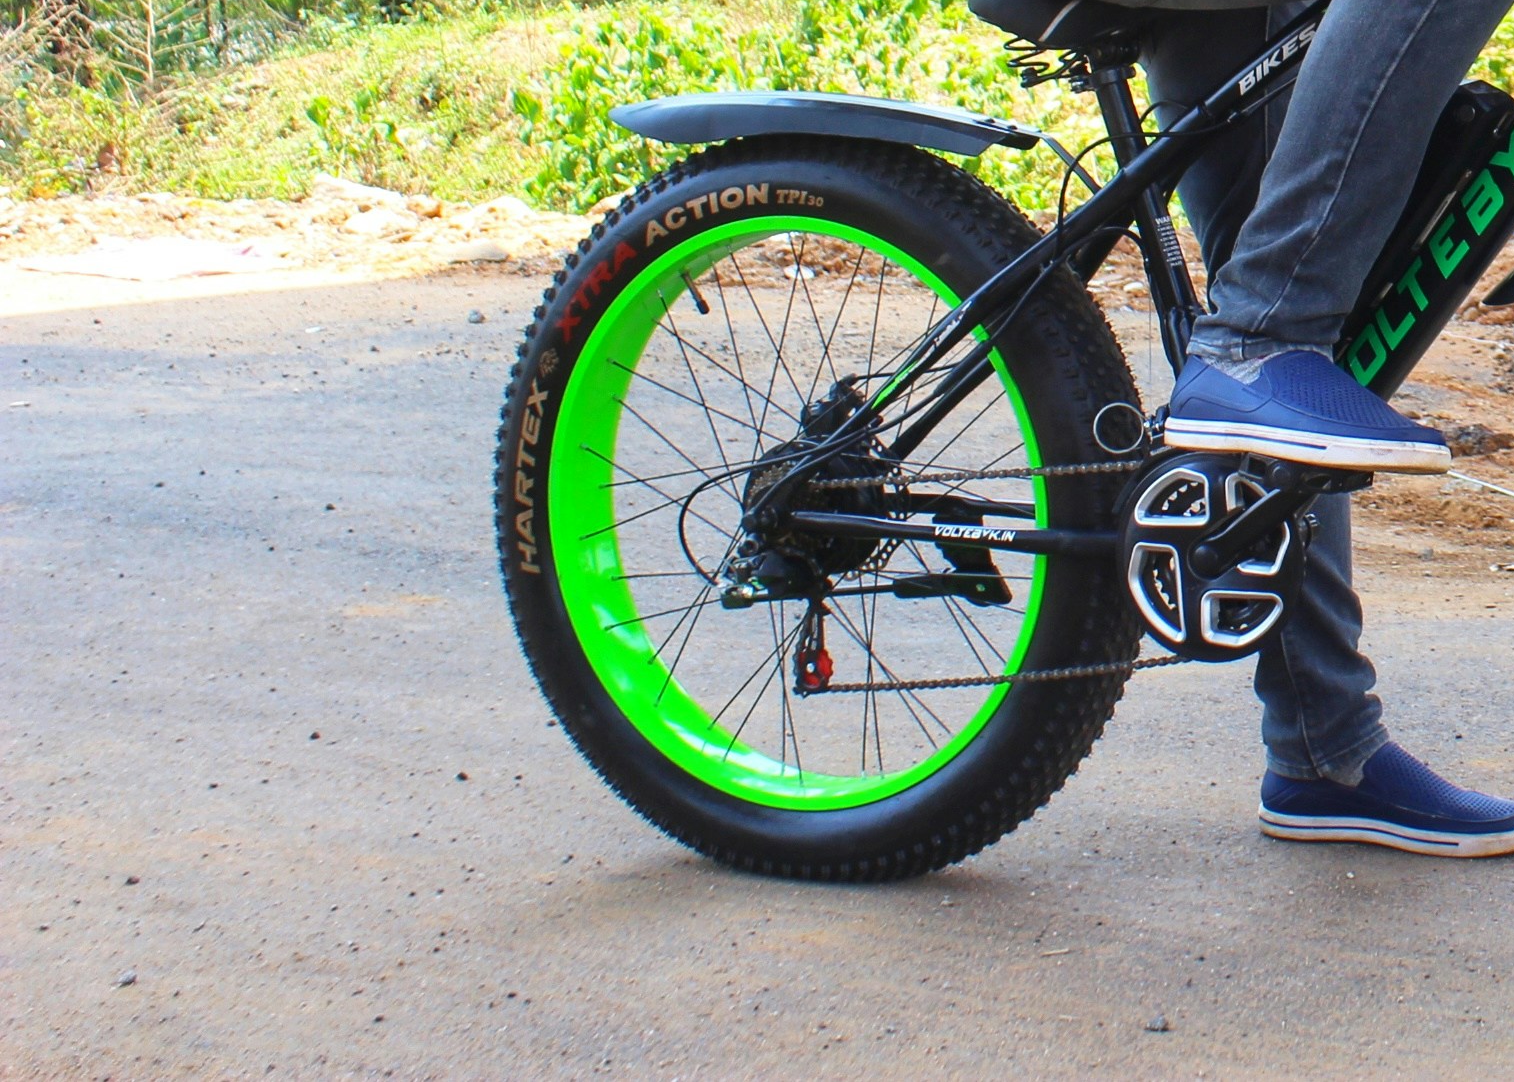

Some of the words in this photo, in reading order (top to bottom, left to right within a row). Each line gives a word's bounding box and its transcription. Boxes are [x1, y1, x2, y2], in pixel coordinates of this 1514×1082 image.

[1238, 22, 1316, 96] BIKES
[515, 378, 549, 574] HARTEX
[556, 240, 637, 343] XTRA
[645, 182, 770, 247] ACTION
